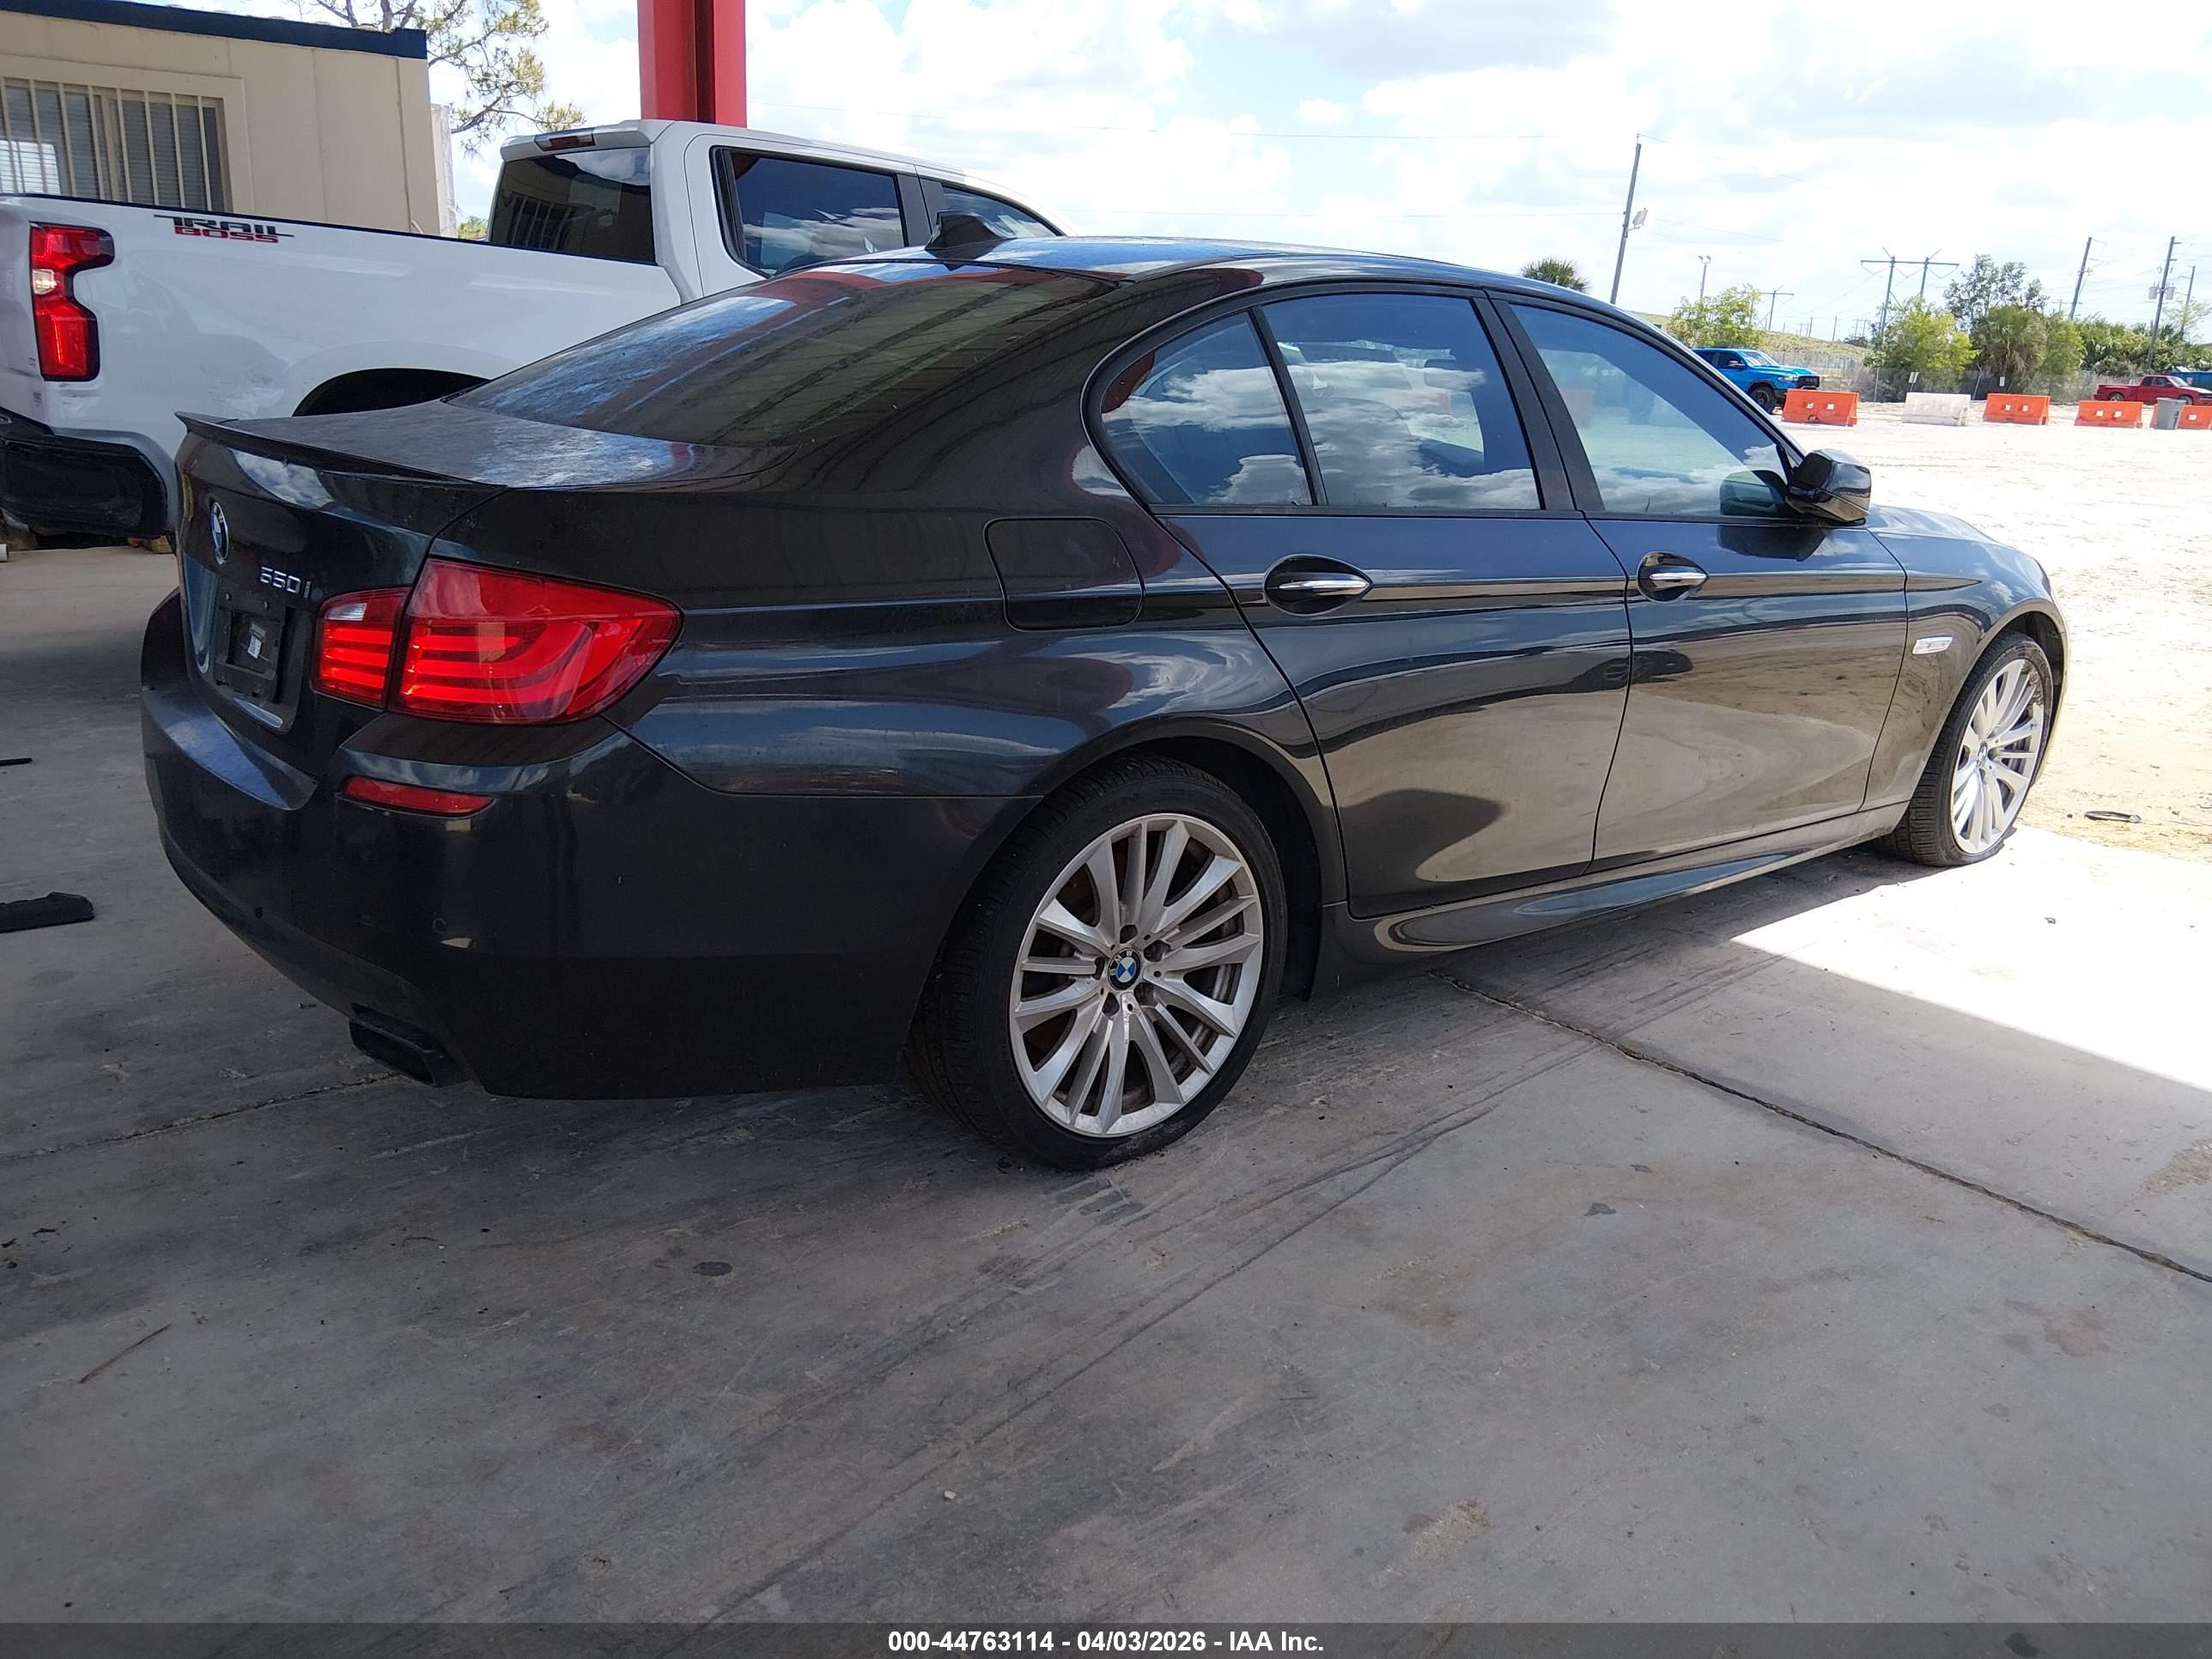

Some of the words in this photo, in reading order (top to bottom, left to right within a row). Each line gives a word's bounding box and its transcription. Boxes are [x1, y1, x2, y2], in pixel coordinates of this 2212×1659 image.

[154, 215, 295, 238] TRAIL
[174, 226, 279, 243] BOSS
[260, 566, 312, 599] 550i
